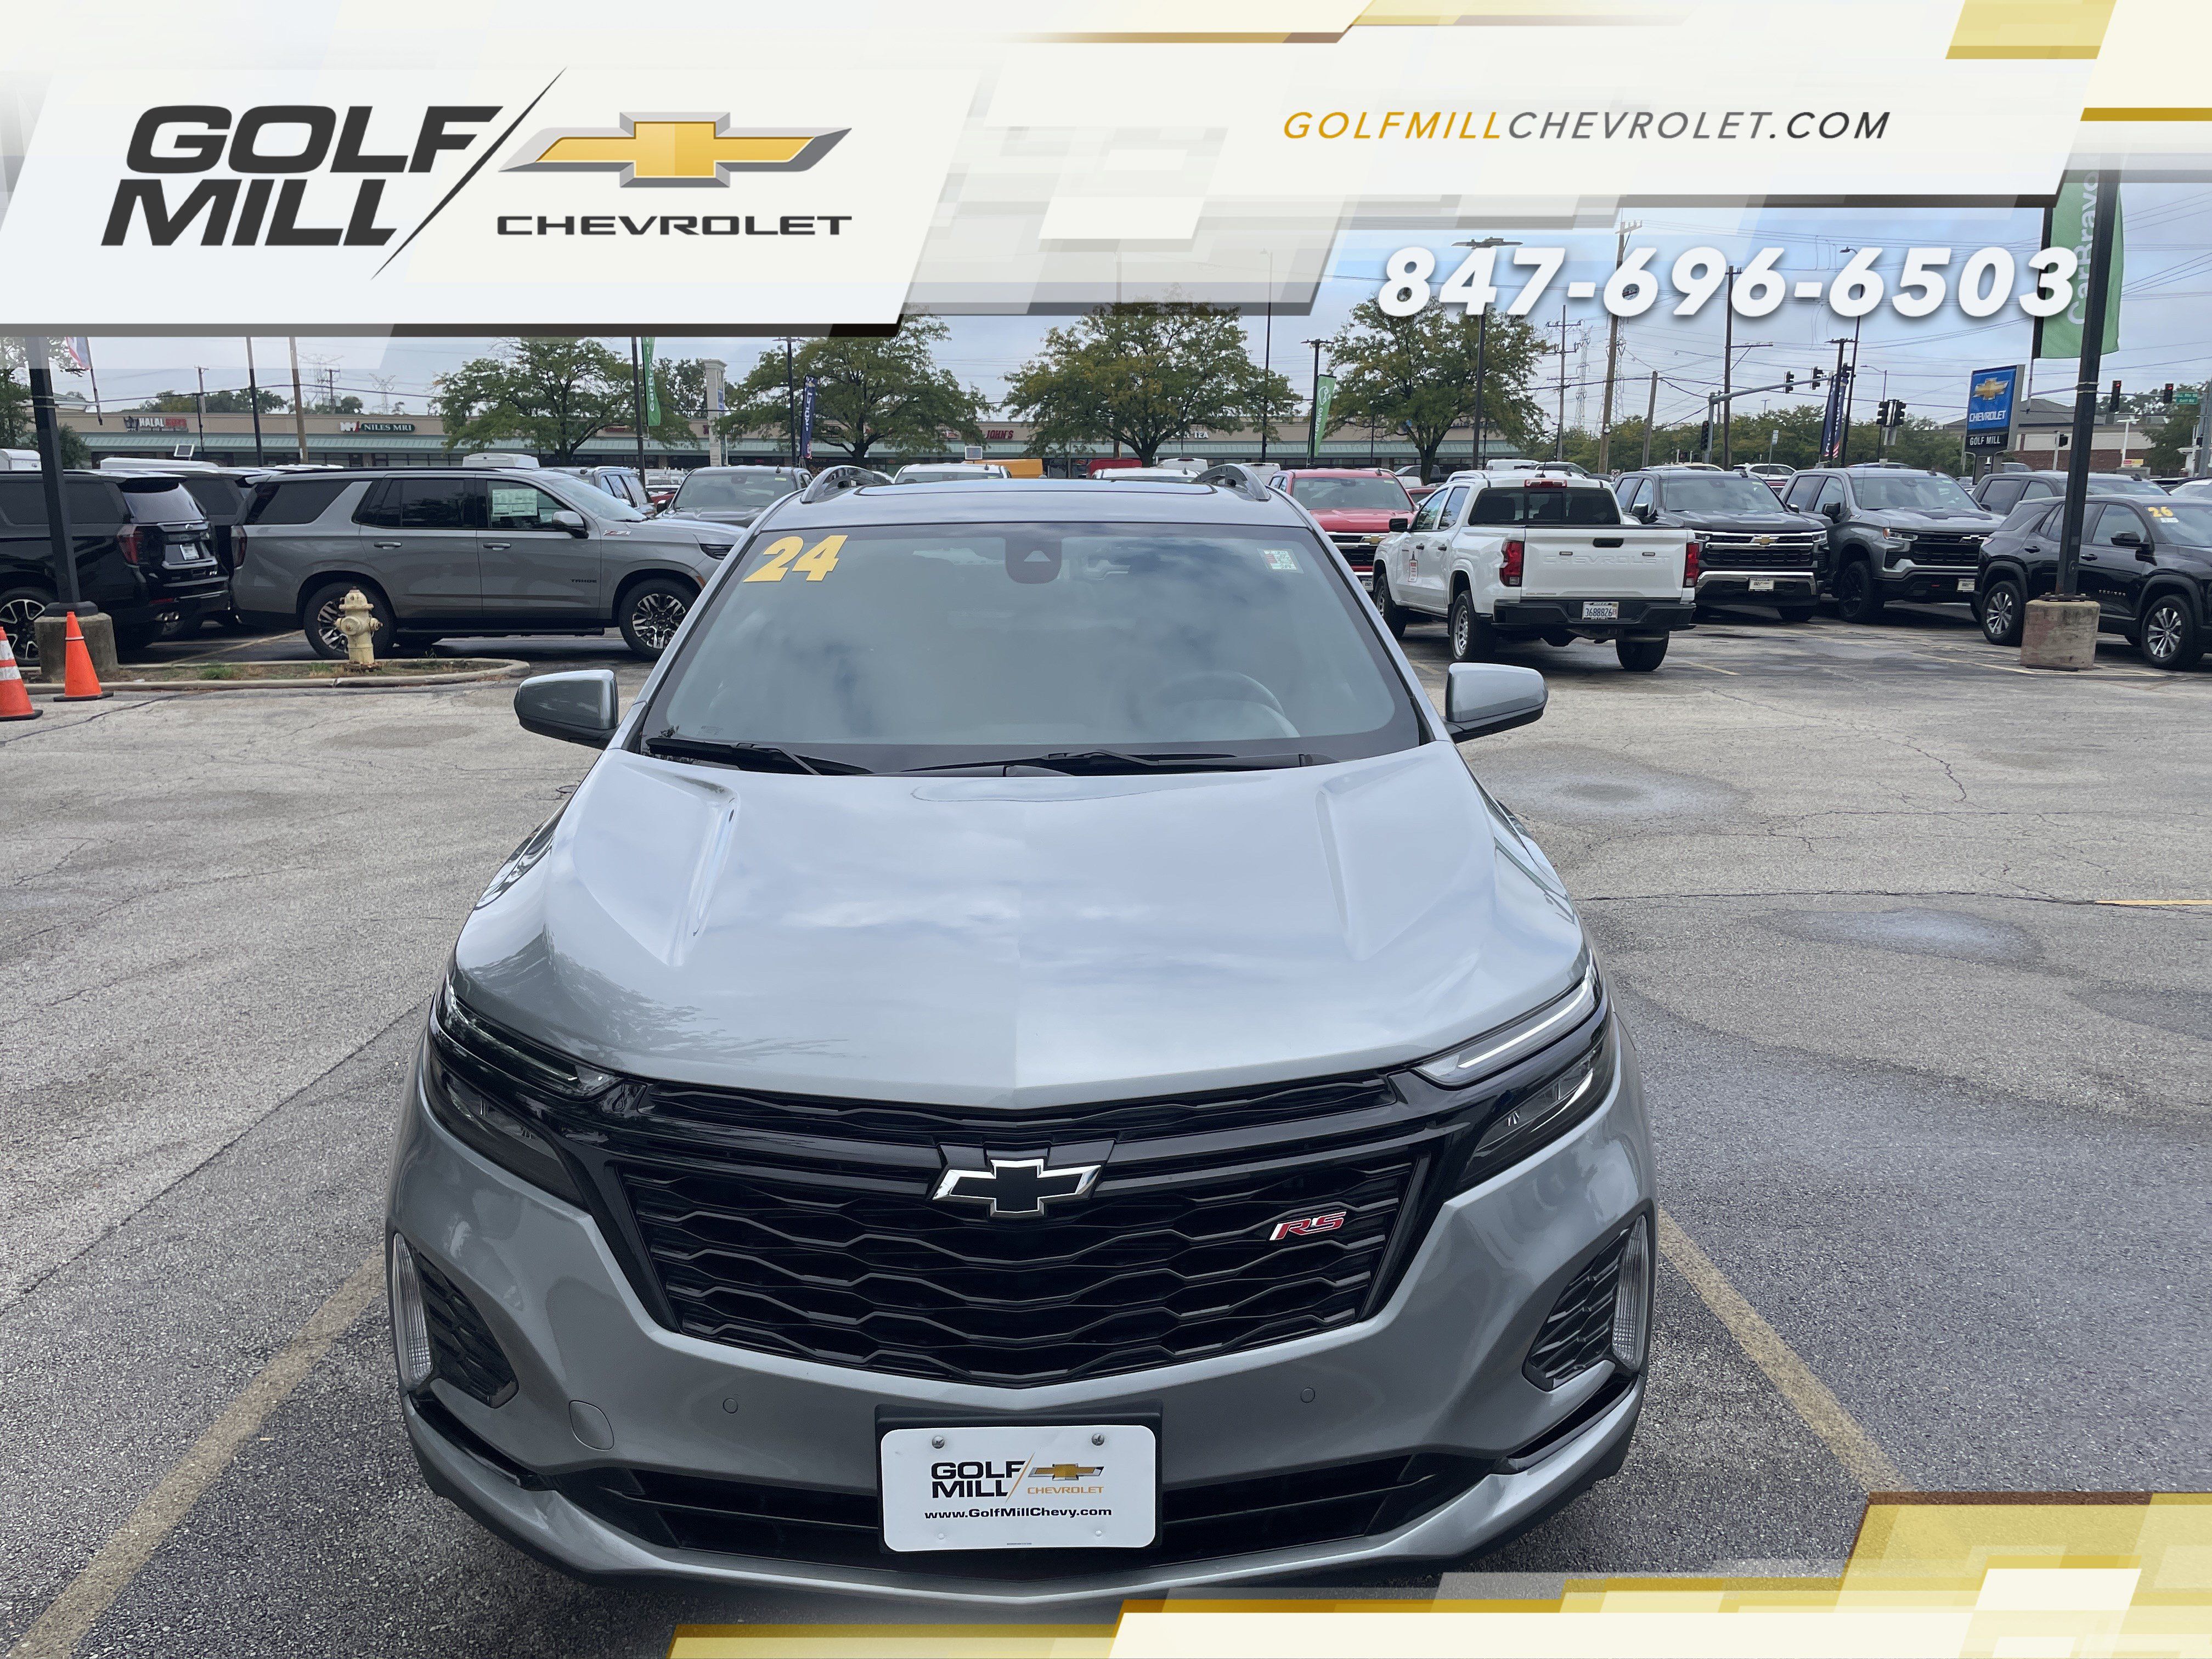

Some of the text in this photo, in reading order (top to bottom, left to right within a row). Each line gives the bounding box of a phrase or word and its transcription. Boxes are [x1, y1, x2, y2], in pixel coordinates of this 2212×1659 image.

[2067, 171, 2100, 325] CarBravo
[138, 417, 165, 427] HALAL
[1969, 410, 2006, 422] CHEVROLET
[1970, 436, 2001, 445] GOLF MILL
[2148, 506, 2174, 517] 26
[743, 535, 849, 583] 24
[1269, 1211, 1347, 1240] RS
[931, 1460, 1025, 1480] GOLF
[932, 1480, 1008, 1499] MILL
[1027, 1486, 1104, 1494] CHEVROLET
[924, 1507, 1113, 1519] www.GolfMillChevy.com
